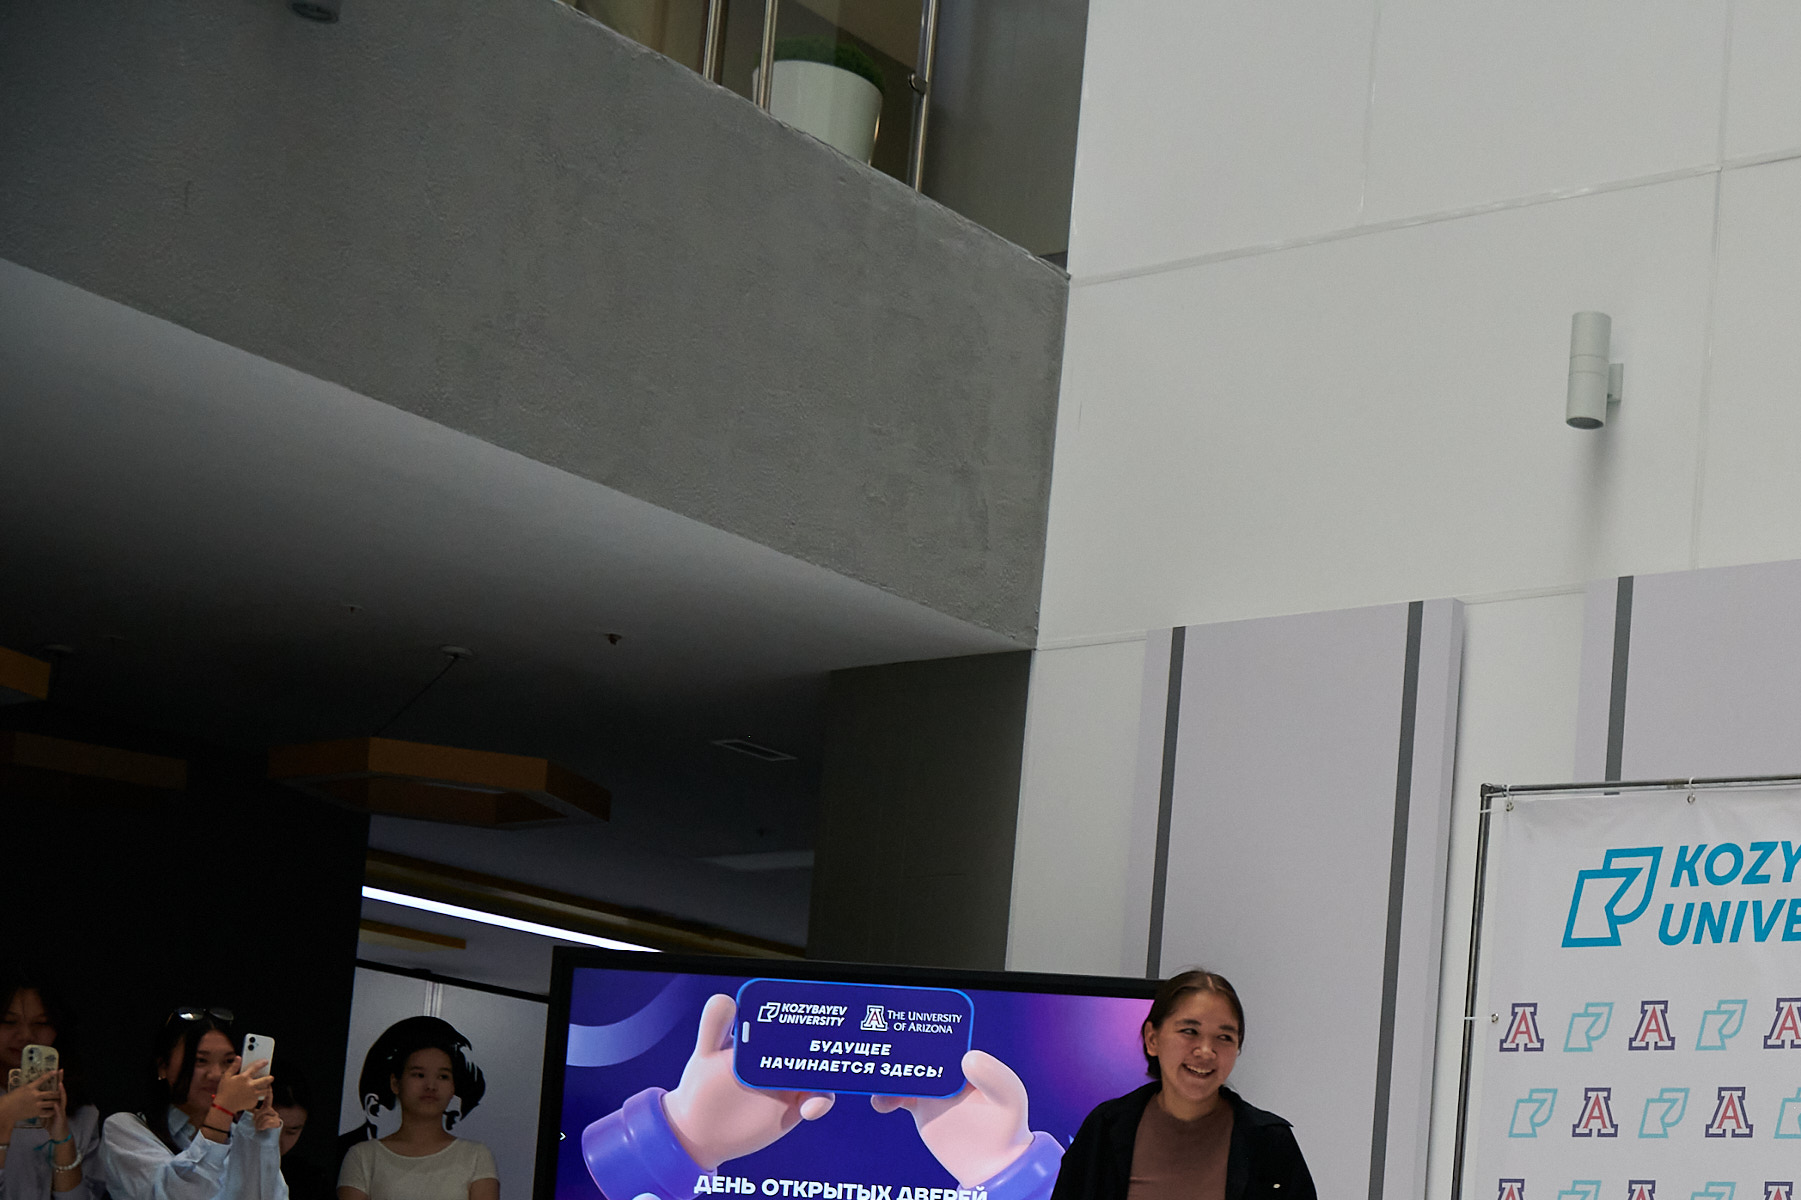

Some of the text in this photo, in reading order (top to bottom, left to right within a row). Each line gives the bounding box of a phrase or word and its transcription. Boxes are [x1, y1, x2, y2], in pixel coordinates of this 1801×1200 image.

[782, 1003, 848, 1016] KOZYBAYEV
[860, 1005, 888, 1032] A
[887, 1010, 963, 1024] THE UNIVERSITY
[779, 1014, 845, 1027] UNIVERSITY
[893, 1022, 953, 1034] OF ARIZONA
[1500, 1003, 1544, 1052] A
[1629, 1000, 1675, 1050] A
[809, 1040, 892, 1056] БУДУЩЕЕ
[760, 1056, 944, 1078] НАЧИНАЕТСЯ ЗДЕСЬ!
[1573, 1088, 1618, 1137] A
[1706, 1087, 1753, 1137] A
[694, 1175, 756, 1195] ДЕНЬ
